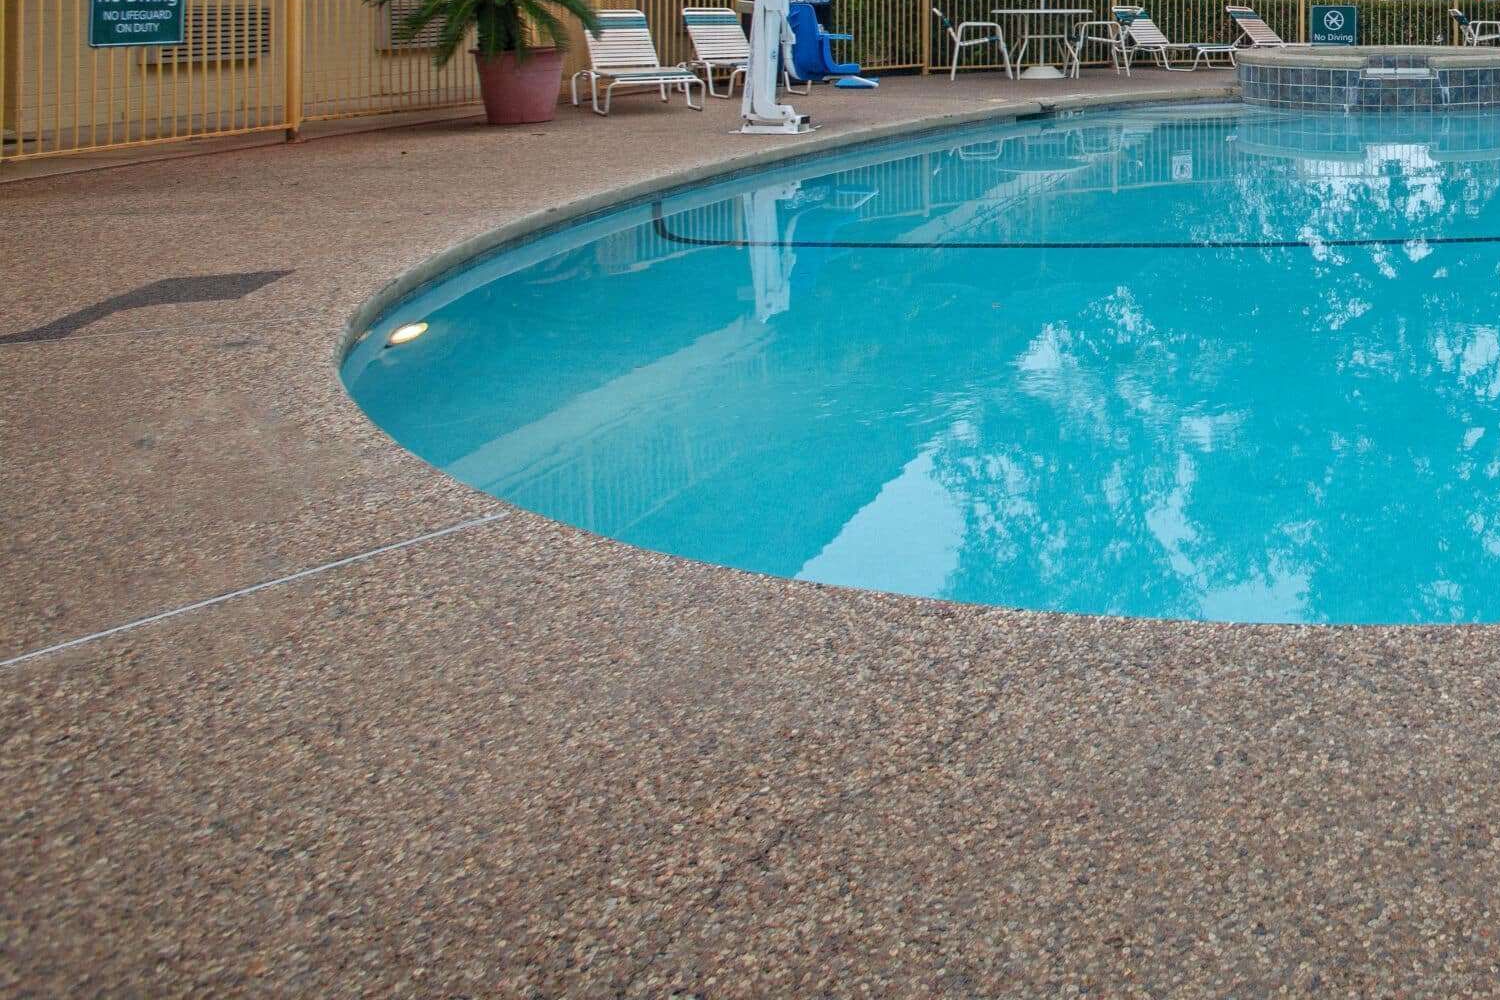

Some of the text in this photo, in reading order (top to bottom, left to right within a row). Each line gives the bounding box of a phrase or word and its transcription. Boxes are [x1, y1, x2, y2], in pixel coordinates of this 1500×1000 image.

[103, 9, 173, 21] NO LIFEGUARD
[115, 22, 159, 33] ON DUTY
[1314, 32, 1354, 43] No Diving
